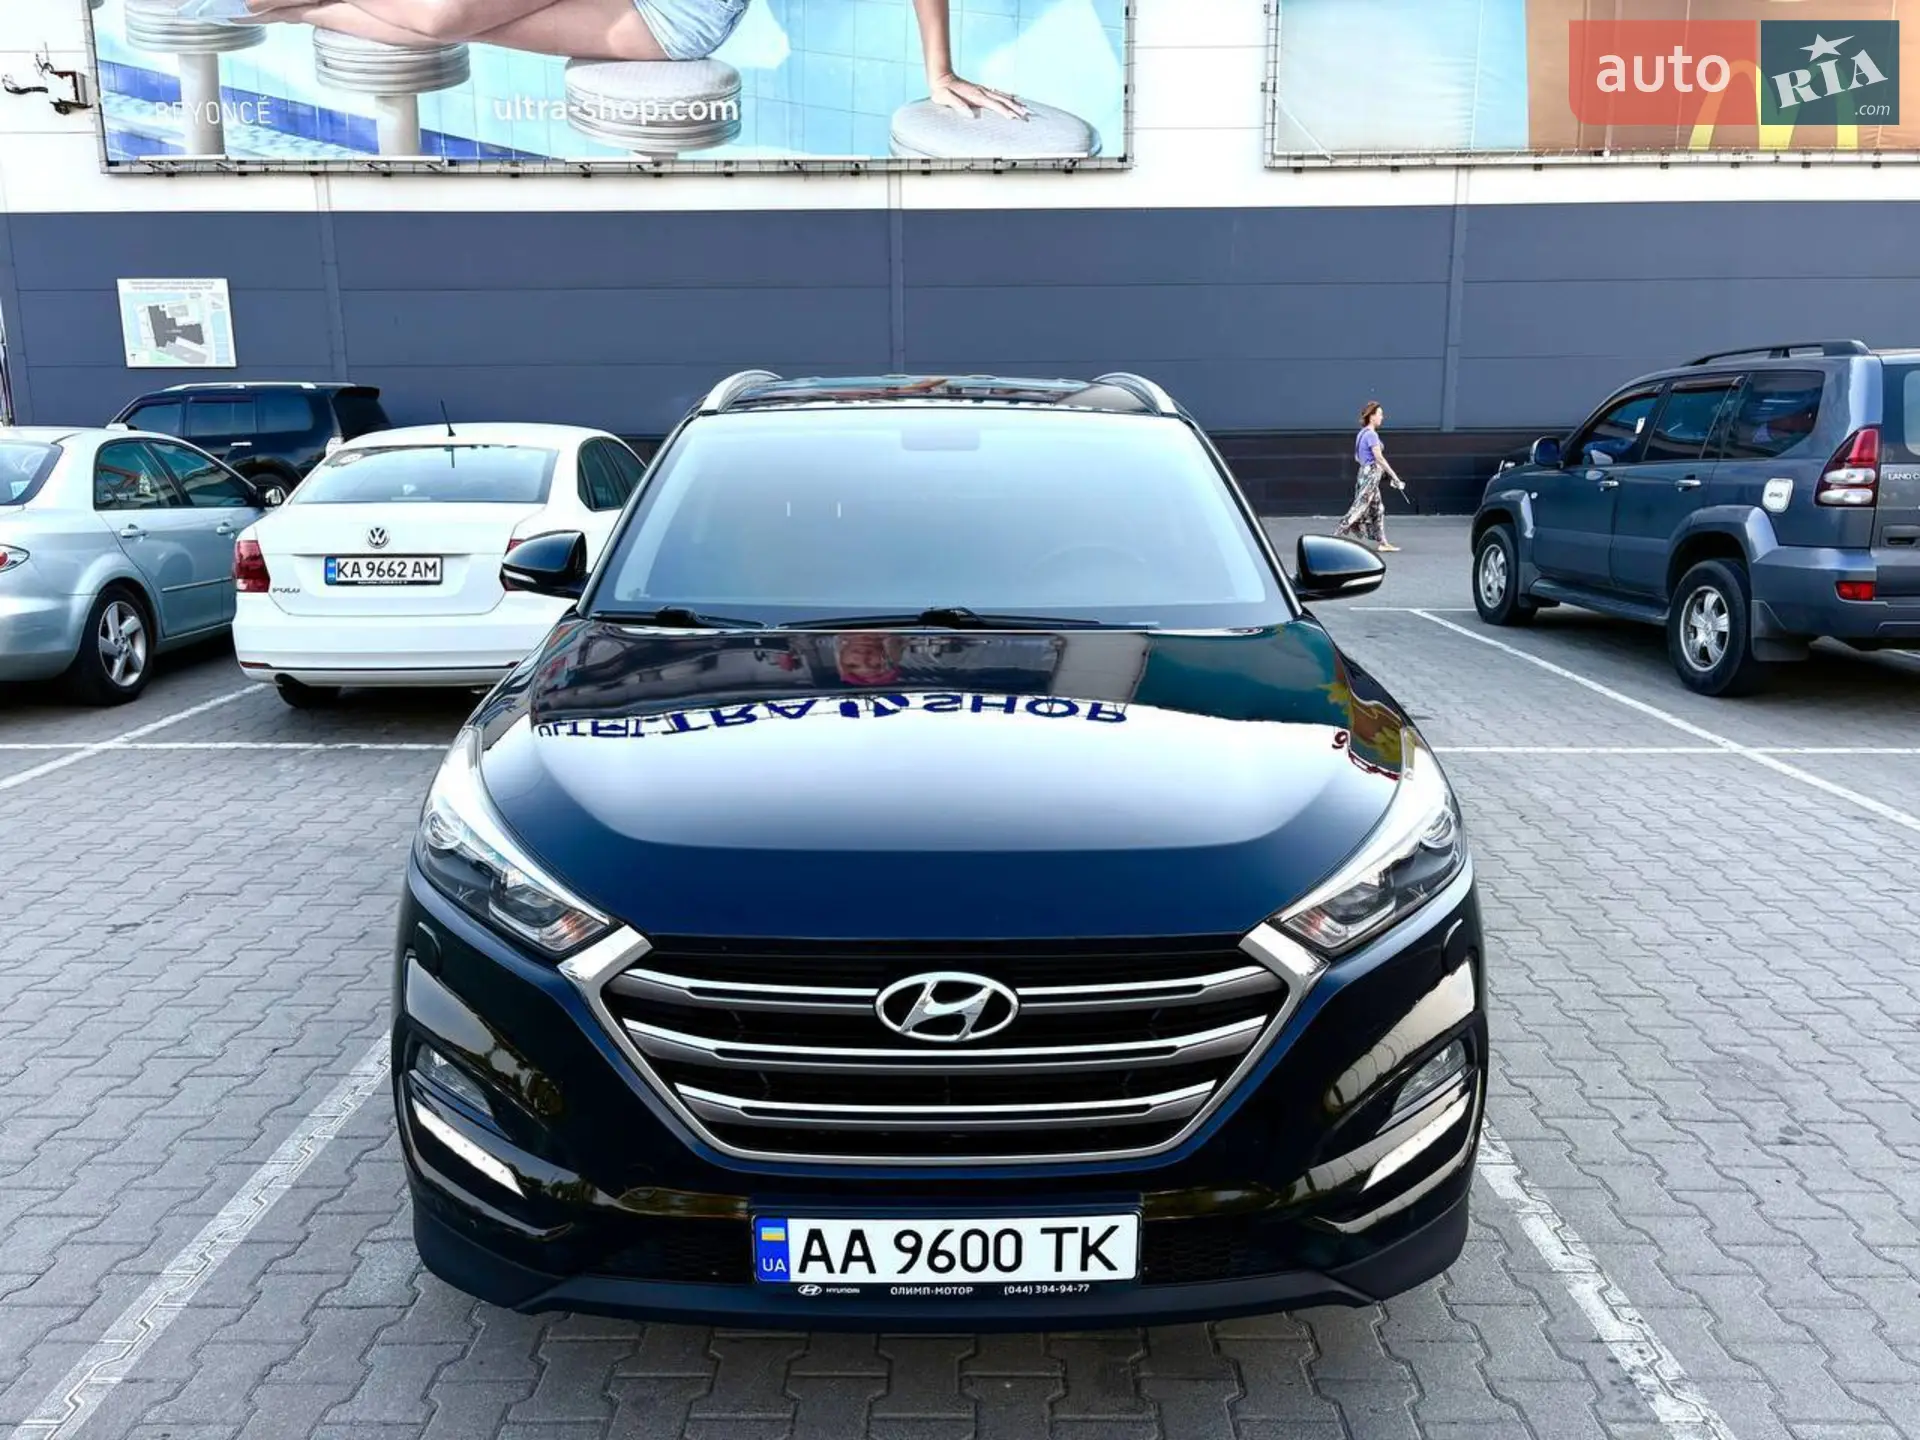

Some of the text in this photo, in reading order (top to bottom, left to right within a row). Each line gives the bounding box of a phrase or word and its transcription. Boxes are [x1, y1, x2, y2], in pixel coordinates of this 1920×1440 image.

[493, 94, 740, 125] ultra-shop.com
[336, 561, 437, 578] KA 9662 AM
[798, 1225, 1120, 1275] AA 9600 TK
[762, 1257, 787, 1272] UA
[1004, 1285, 1033, 1295] (044)
[1035, 1284, 1090, 1294] 394-94-77
